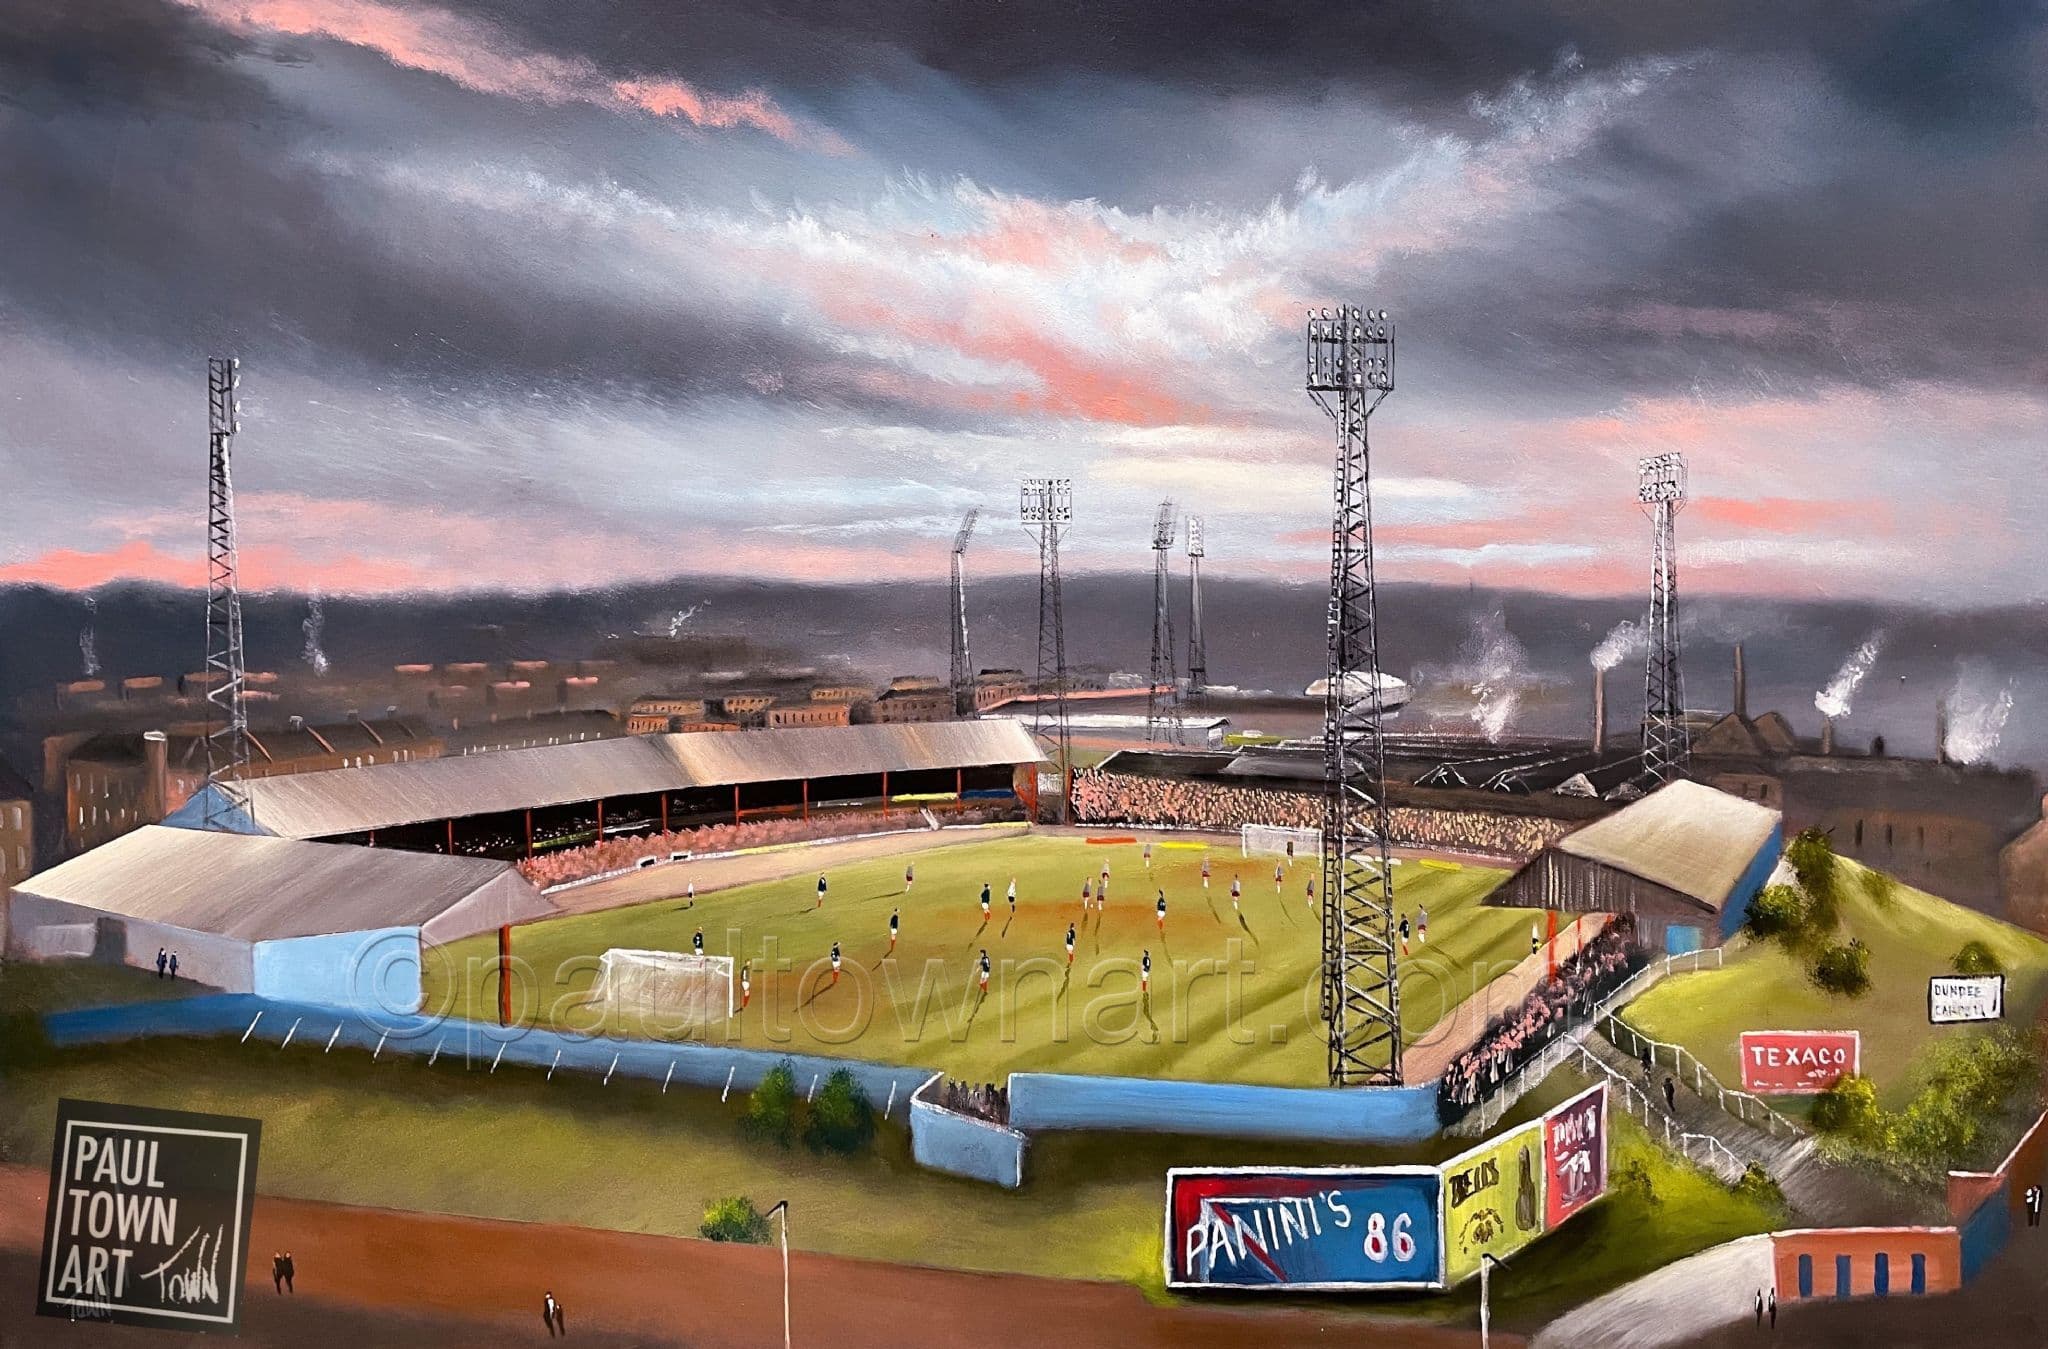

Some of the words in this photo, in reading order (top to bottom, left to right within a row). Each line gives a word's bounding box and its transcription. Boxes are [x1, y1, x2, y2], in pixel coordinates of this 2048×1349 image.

[1934, 984, 1982, 998] DUNDEE
[1750, 1046, 1846, 1067] TEXACO
[1186, 1191, 1352, 1275] PANINI'S
[1363, 1212, 1416, 1263] 86
